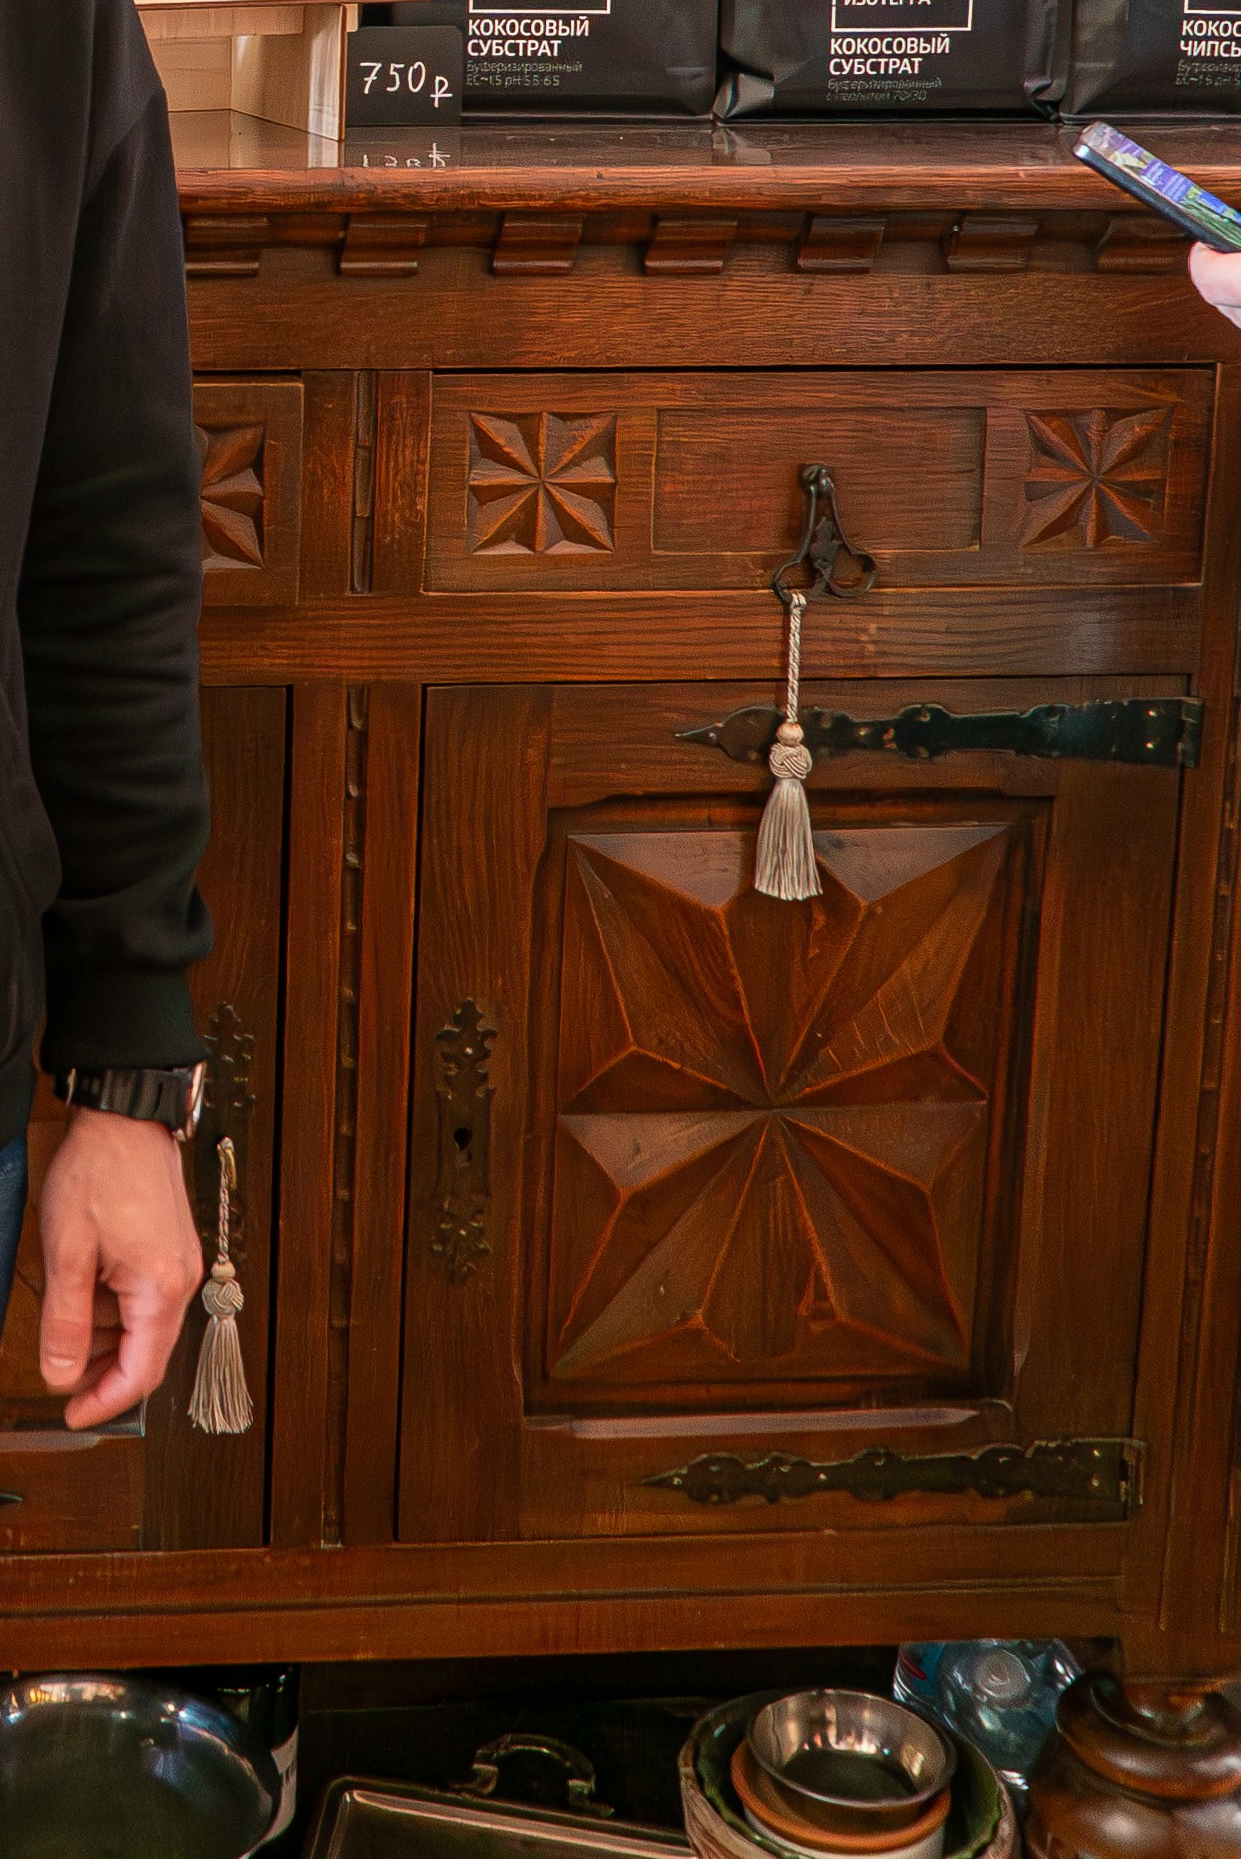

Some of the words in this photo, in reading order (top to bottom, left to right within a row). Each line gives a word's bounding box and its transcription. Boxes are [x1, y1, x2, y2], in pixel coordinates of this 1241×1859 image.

[468, 16, 589, 37] КОКОСОВЫЙ
[467, 39, 562, 57] СУБСТРАТ
[830, 33, 950, 54] КОКОСОВЫЙ
[829, 58, 923, 75] СУБСТРАТ
